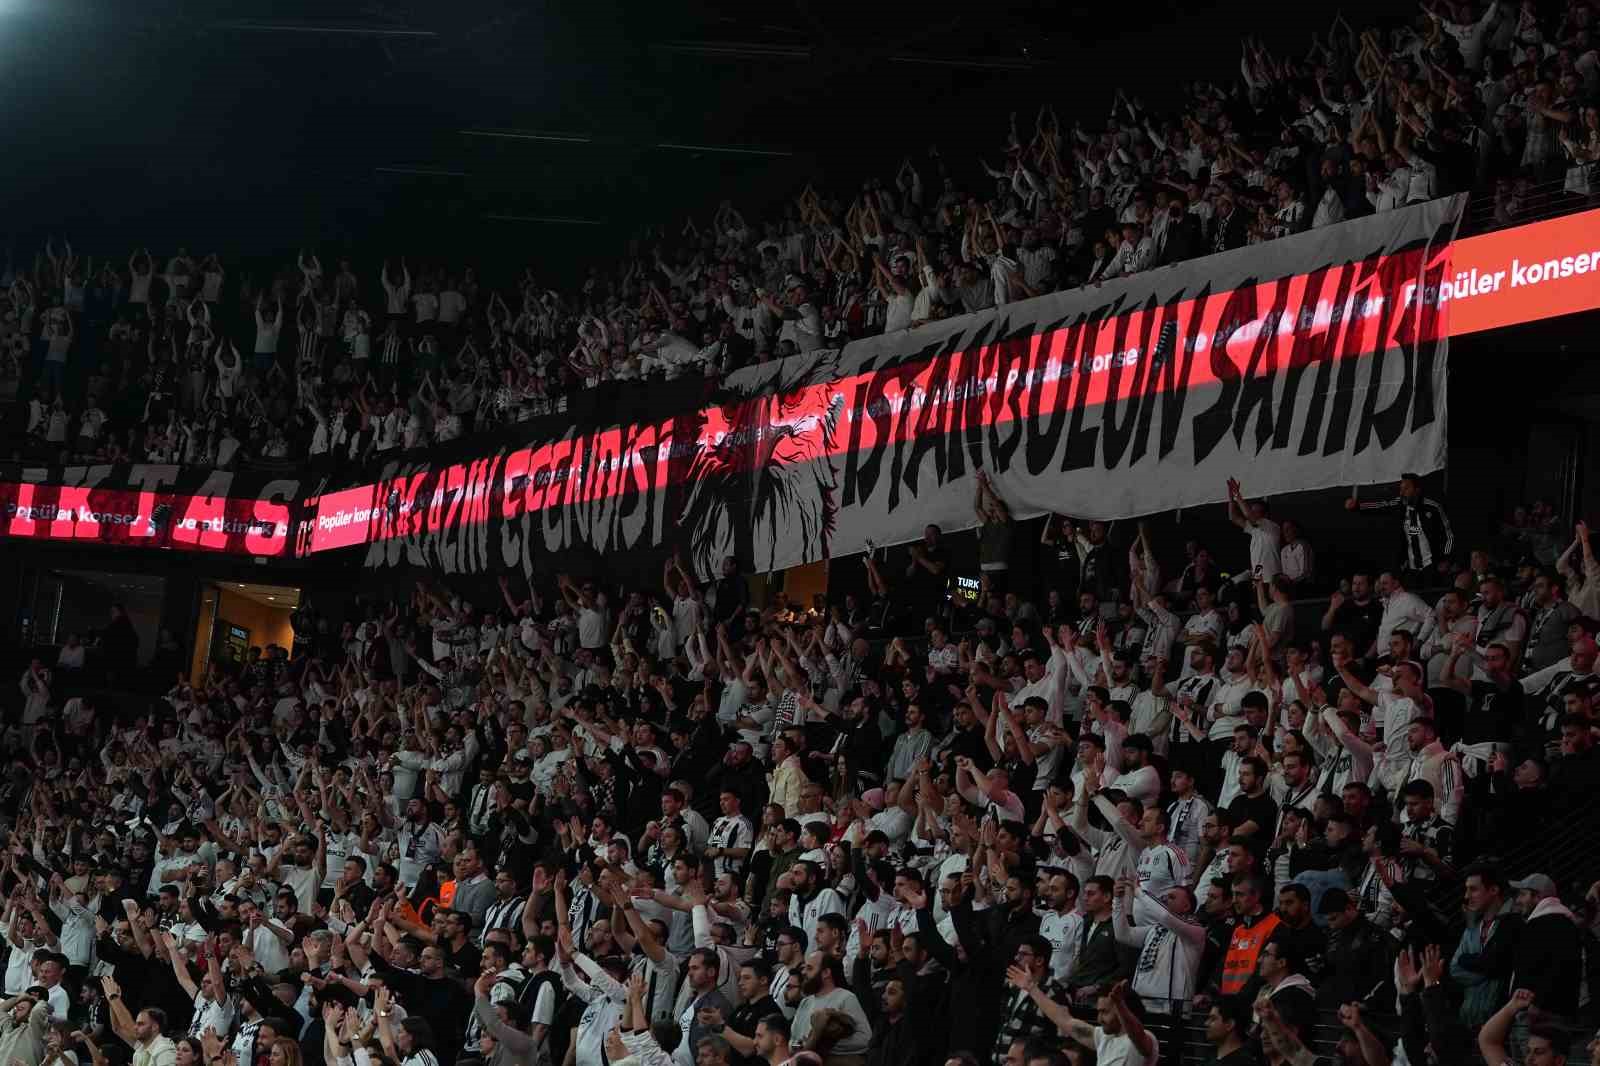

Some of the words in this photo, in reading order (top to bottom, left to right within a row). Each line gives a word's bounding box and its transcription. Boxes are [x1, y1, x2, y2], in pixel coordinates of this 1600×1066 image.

[1404, 268, 1505, 310] Popüler
[1511, 250, 1600, 289] konser
[79, 505, 141, 526] konser
[319, 511, 353, 533] Popüler
